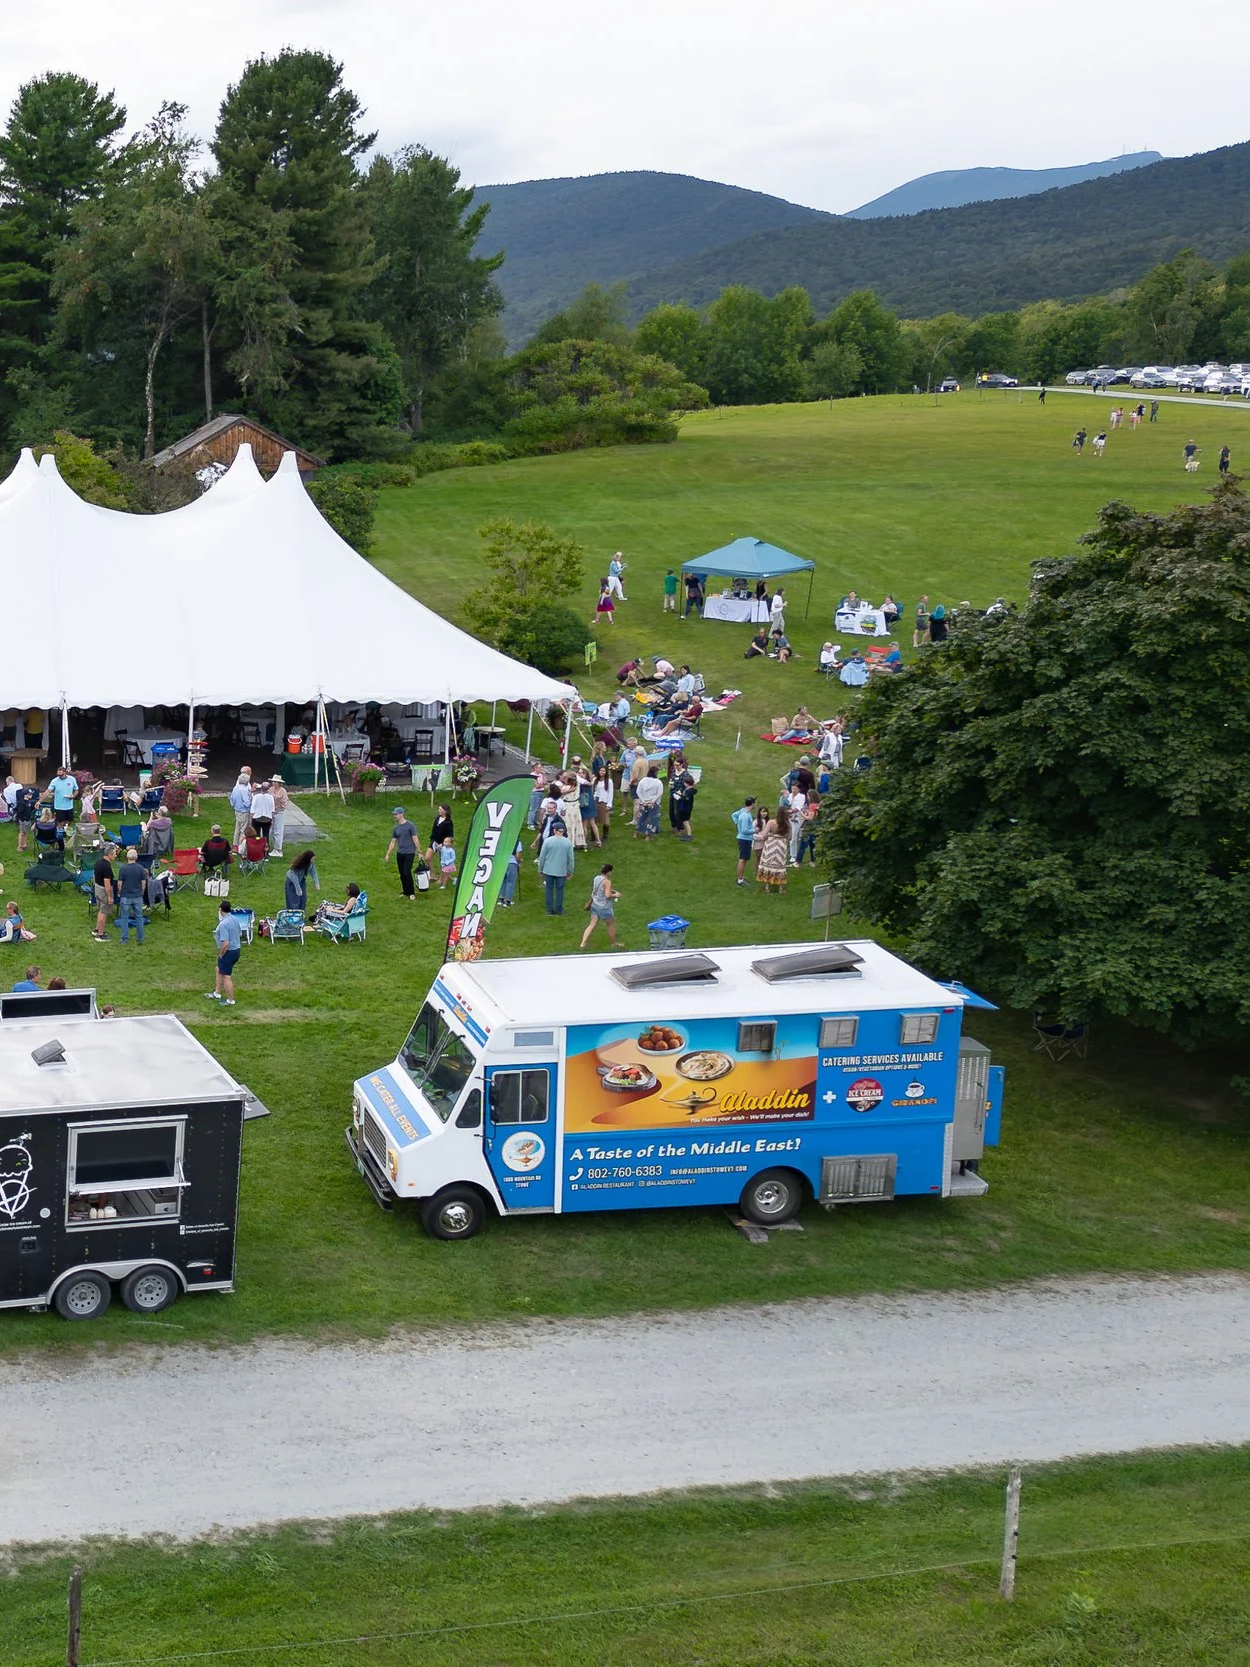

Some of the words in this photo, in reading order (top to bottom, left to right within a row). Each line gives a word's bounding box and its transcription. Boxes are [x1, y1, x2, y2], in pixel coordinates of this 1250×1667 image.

[822, 1056, 861, 1067] CATERING
[862, 1054, 900, 1065] SERVICES
[901, 1052, 944, 1063] AVAILABLE
[848, 1089, 859, 1097] ICE
[860, 1088, 882, 1096] CREAM
[719, 1088, 811, 1113] Aladdin
[569, 1149, 583, 1160] A
[586, 1146, 632, 1160] Taste
[636, 1145, 653, 1158] of
[658, 1144, 686, 1157] the
[690, 1141, 751, 1156] Middle
[754, 1138, 801, 1153] East!
[587, 1165, 663, 1179] 802-760-6383
[580, 1182, 602, 1190] ALADDIN
[602, 1181, 635, 1189] RESTAURANT
